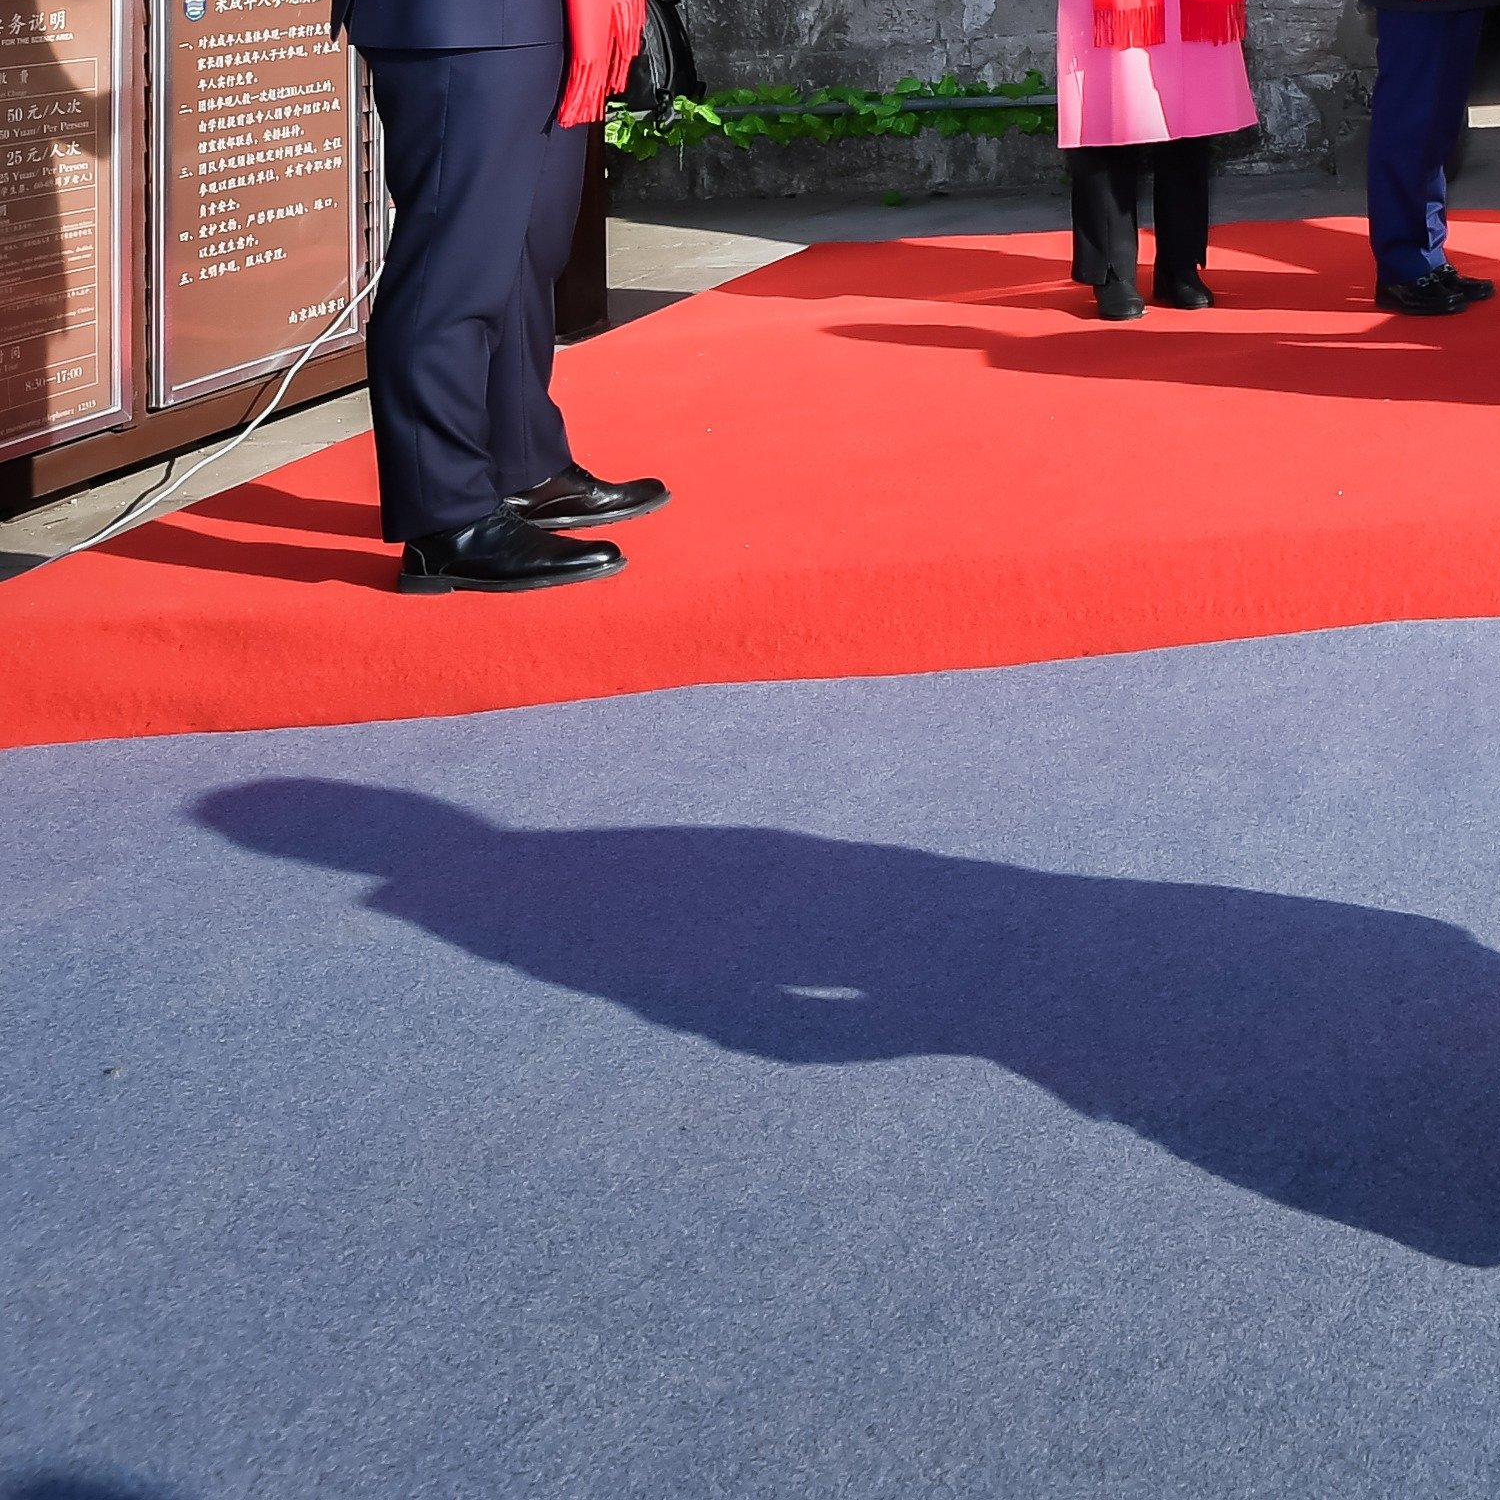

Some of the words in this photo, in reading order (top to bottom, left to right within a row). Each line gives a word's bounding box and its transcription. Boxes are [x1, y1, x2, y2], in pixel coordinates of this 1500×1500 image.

[0, 9, 66, 35] 务说明
[43, 123, 58, 133] Per
[60, 120, 90, 131] Person
[42, 166, 57, 176] Per
[59, 162, 89, 173] Person
